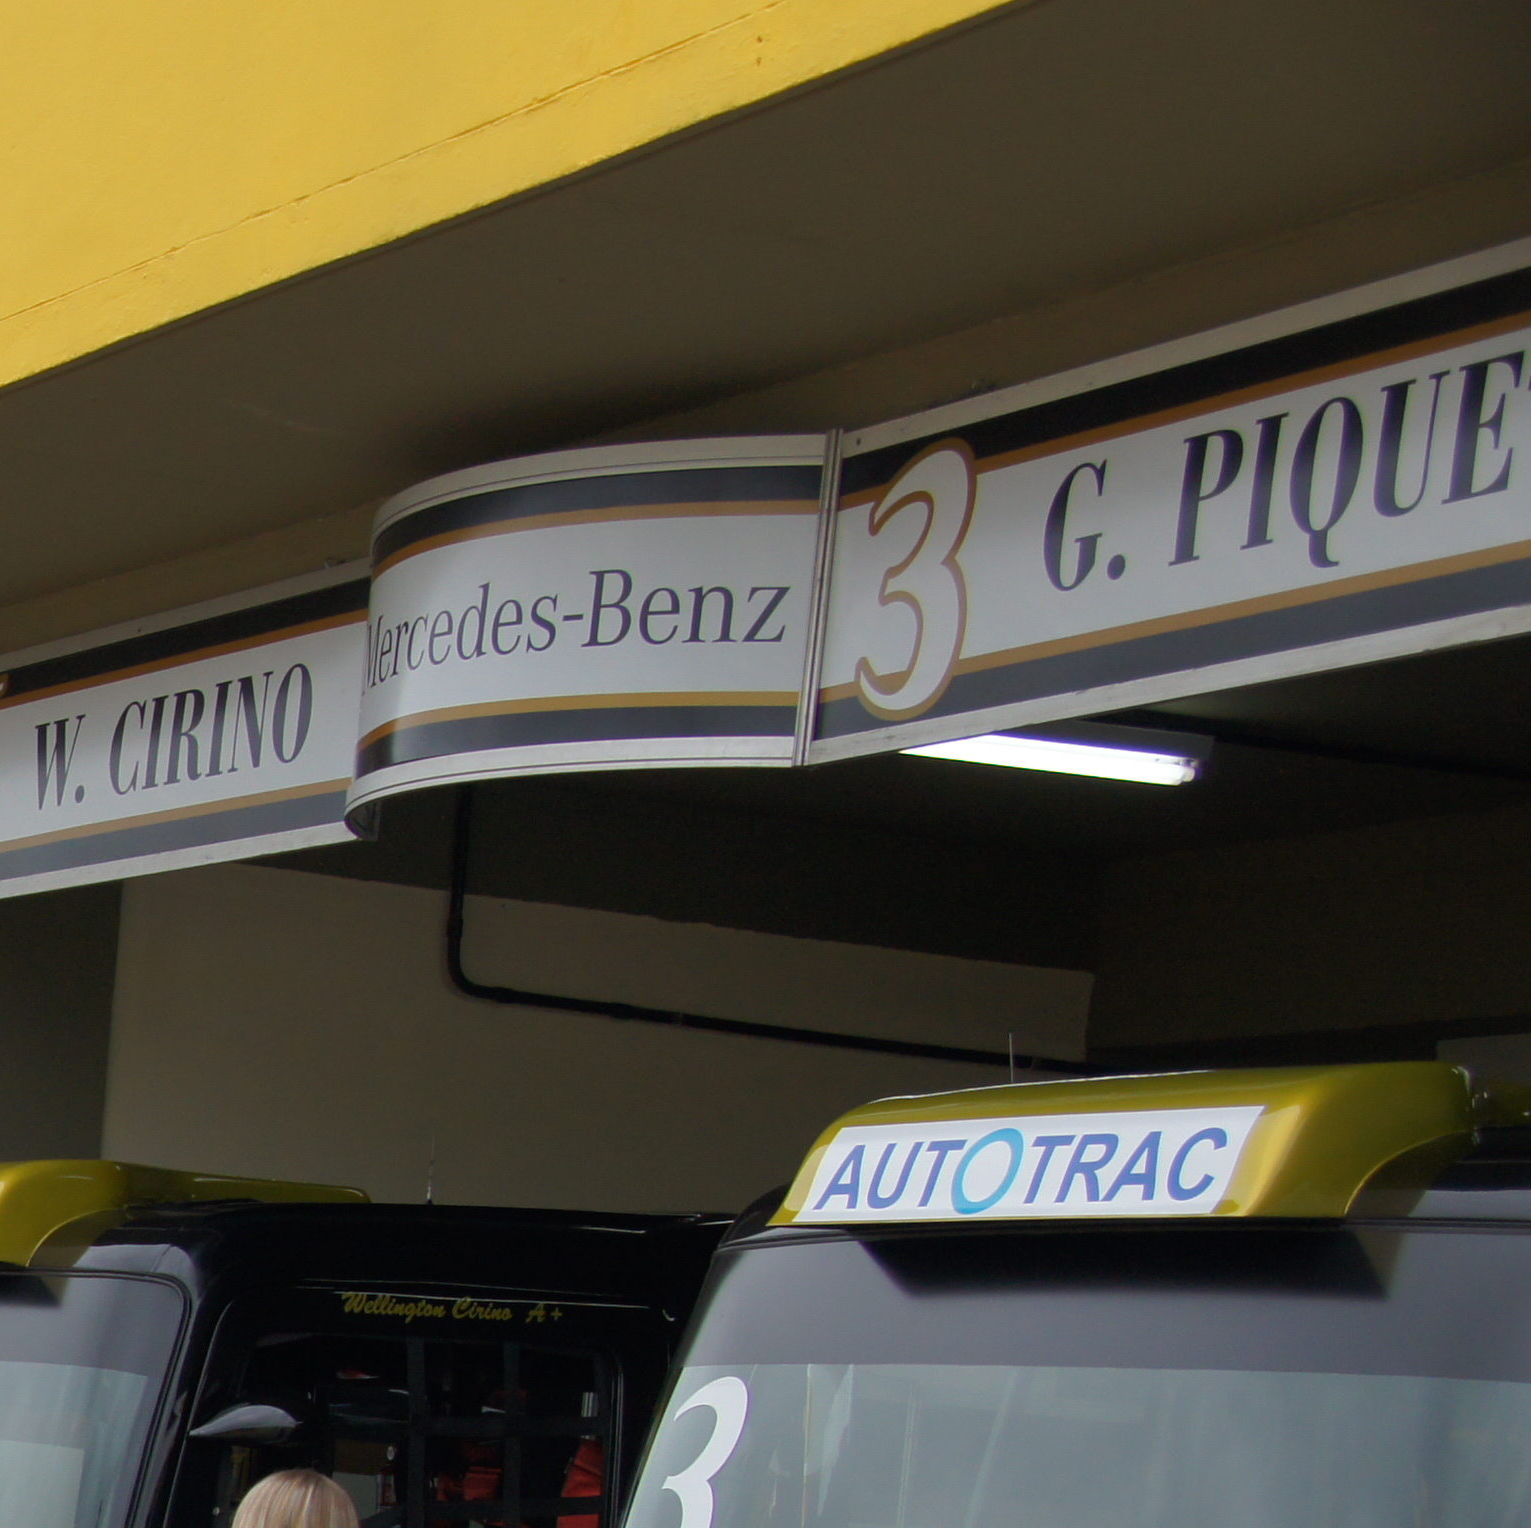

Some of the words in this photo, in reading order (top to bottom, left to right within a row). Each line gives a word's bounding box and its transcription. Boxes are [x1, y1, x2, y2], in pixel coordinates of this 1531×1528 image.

[1042, 458, 1125, 596] G.
[1167, 348, 1531, 572] PIQUE
[364, 563, 789, 697] Mercedes-Benz
[852, 435, 977, 721] 3
[33, 713, 87, 812] W.
[107, 661, 313, 797] CIRINO
[812, 1126, 1228, 1215] AUTOTRAC
[342, 1291, 446, 1323] Wellington
[452, 1297, 513, 1321] Cirino
